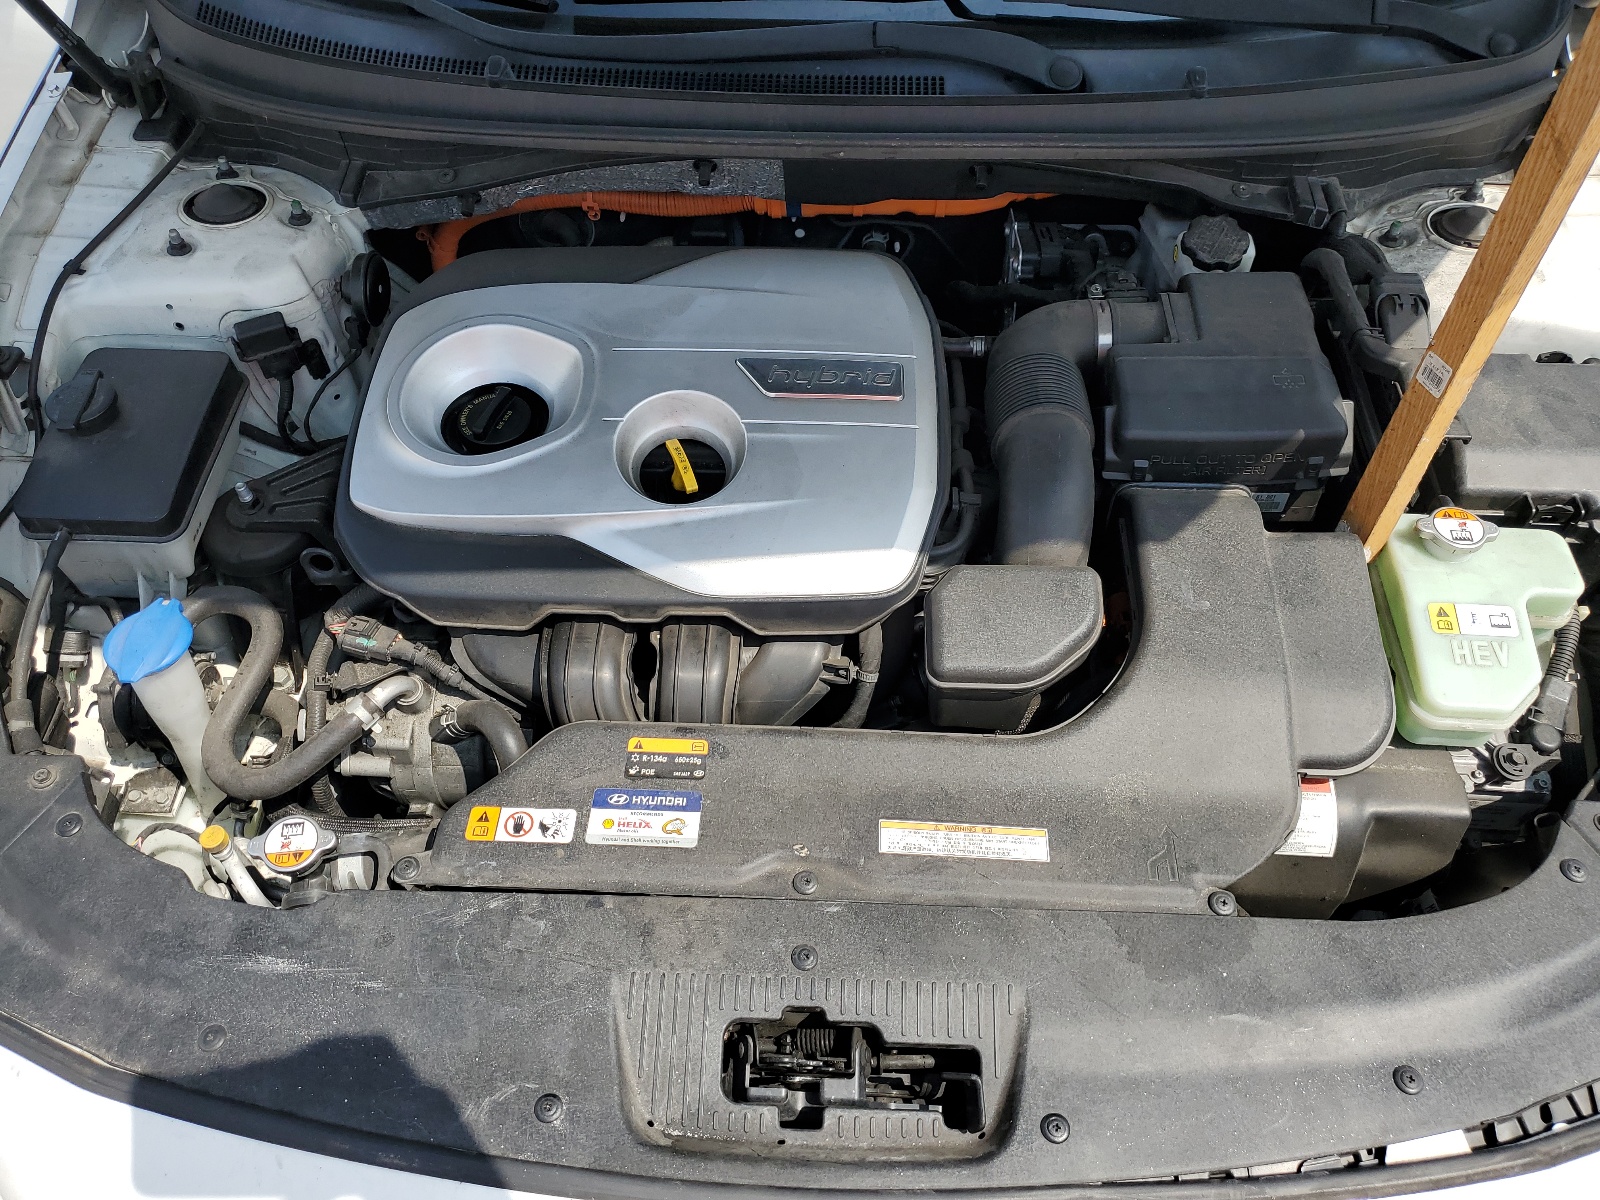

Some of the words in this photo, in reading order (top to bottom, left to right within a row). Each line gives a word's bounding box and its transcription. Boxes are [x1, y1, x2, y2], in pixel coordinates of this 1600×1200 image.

[767, 364, 897, 388] hybrid
[1150, 454, 1191, 465] PULL
[1196, 454, 1231, 465] OUT
[1235, 454, 1256, 464] TO
[1260, 452, 1305, 463] OPEN
[1450, 639, 1510, 668] HEV
[642, 754, 668, 763] R-134a
[632, 795, 687, 806] HYUNDAI
[617, 819, 652, 829] HELIX
[944, 825, 977, 833] WARNING
